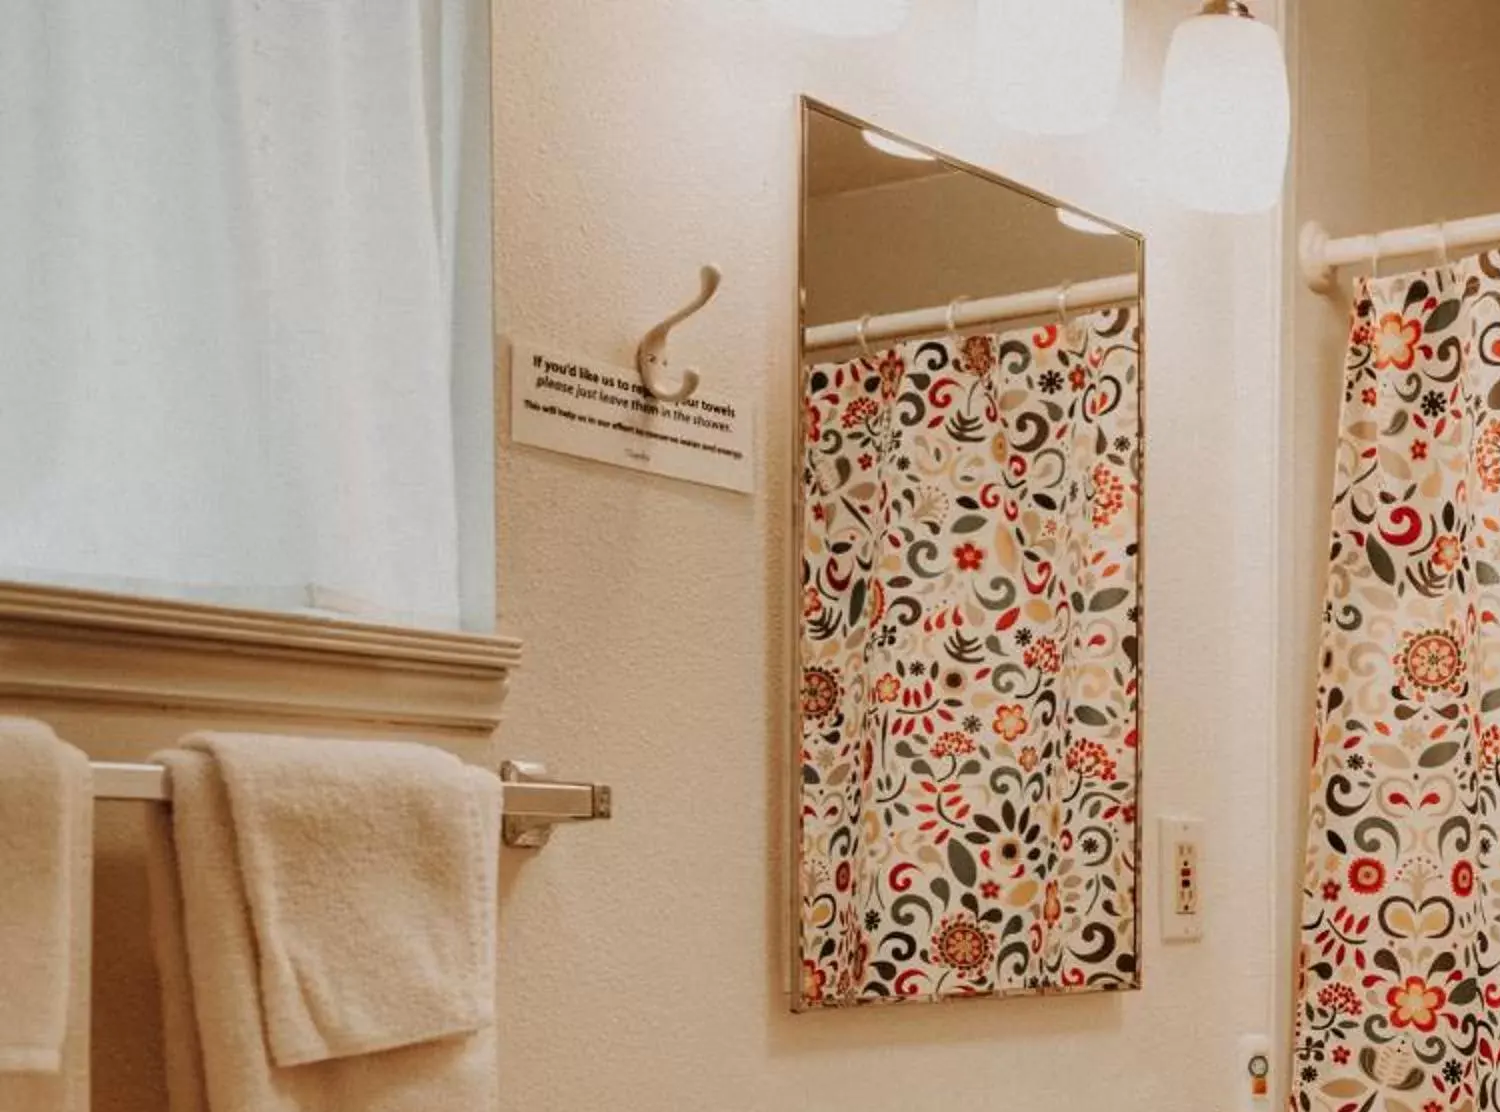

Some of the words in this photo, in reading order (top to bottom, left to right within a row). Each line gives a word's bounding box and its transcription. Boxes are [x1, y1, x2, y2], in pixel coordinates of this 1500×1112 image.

[533, 355, 542, 367] If
[545, 360, 576, 377] you'd
[579, 367, 599, 382] like
[601, 375, 614, 387] us
[617, 378, 629, 391] to
[701, 400, 735, 418] towels
[536, 376, 574, 394] please
[575, 384, 597, 399] just
[600, 389, 629, 408] leave
[631, 399, 658, 416] them
[662, 406, 671, 418] in
[673, 410, 690, 424] the
[693, 415, 733, 433] shower.
